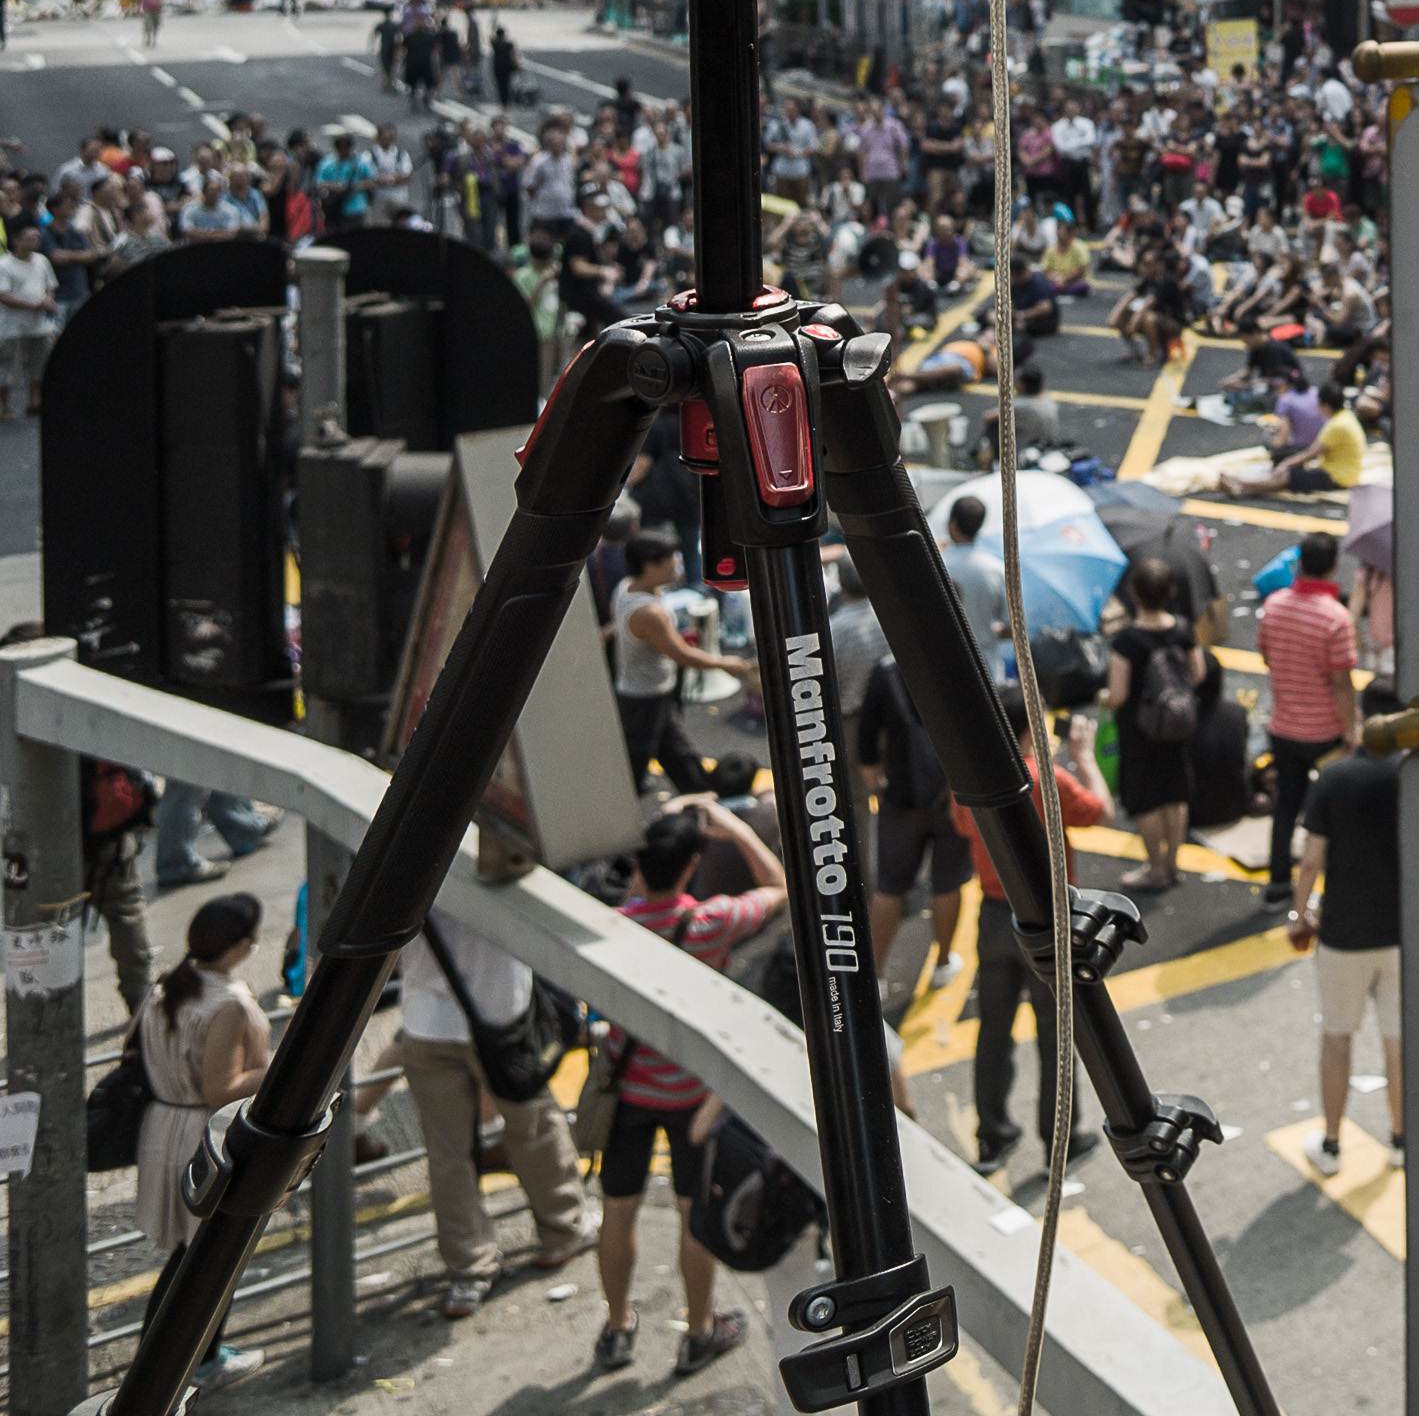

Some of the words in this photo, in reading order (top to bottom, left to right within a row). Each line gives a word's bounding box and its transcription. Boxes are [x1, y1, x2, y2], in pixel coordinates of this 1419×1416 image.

[785, 632, 848, 897] Manfrotto
[820, 910, 859, 973] 190
[828, 976, 840, 1002] made
[832, 1002, 841, 1013] in
[833, 1013, 844, 1033] Italy
